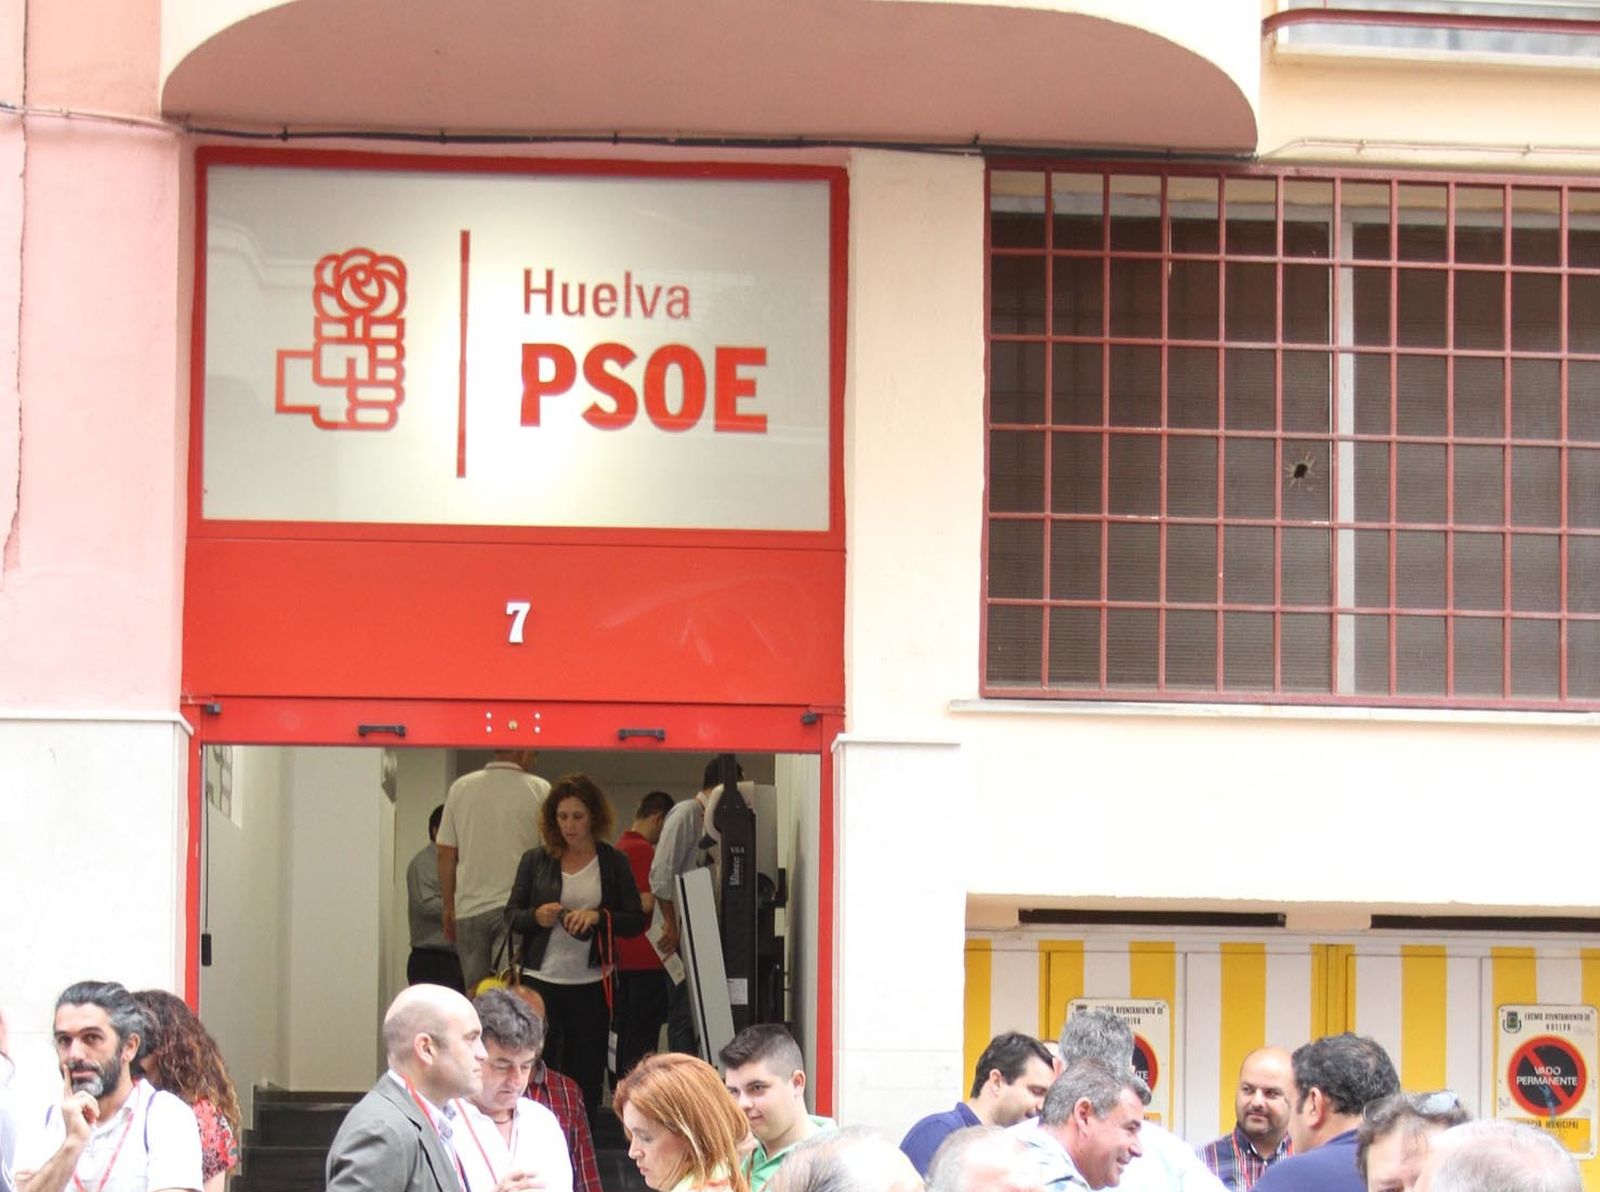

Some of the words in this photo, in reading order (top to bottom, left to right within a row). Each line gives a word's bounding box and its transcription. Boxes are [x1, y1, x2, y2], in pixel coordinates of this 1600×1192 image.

[523, 268, 690, 319] Huelva
[520, 342, 768, 433] PSOE
[506, 602, 531, 643] 7
[1115, 1005, 1156, 1015] AYUNTAMIENTO
[1545, 1012, 1583, 1021] AYUNTAMIENTO
[1545, 1022, 1571, 1031] HUELVA
[1534, 1066, 1561, 1075] VADO
[1516, 1076, 1578, 1086] PERMANENTE
